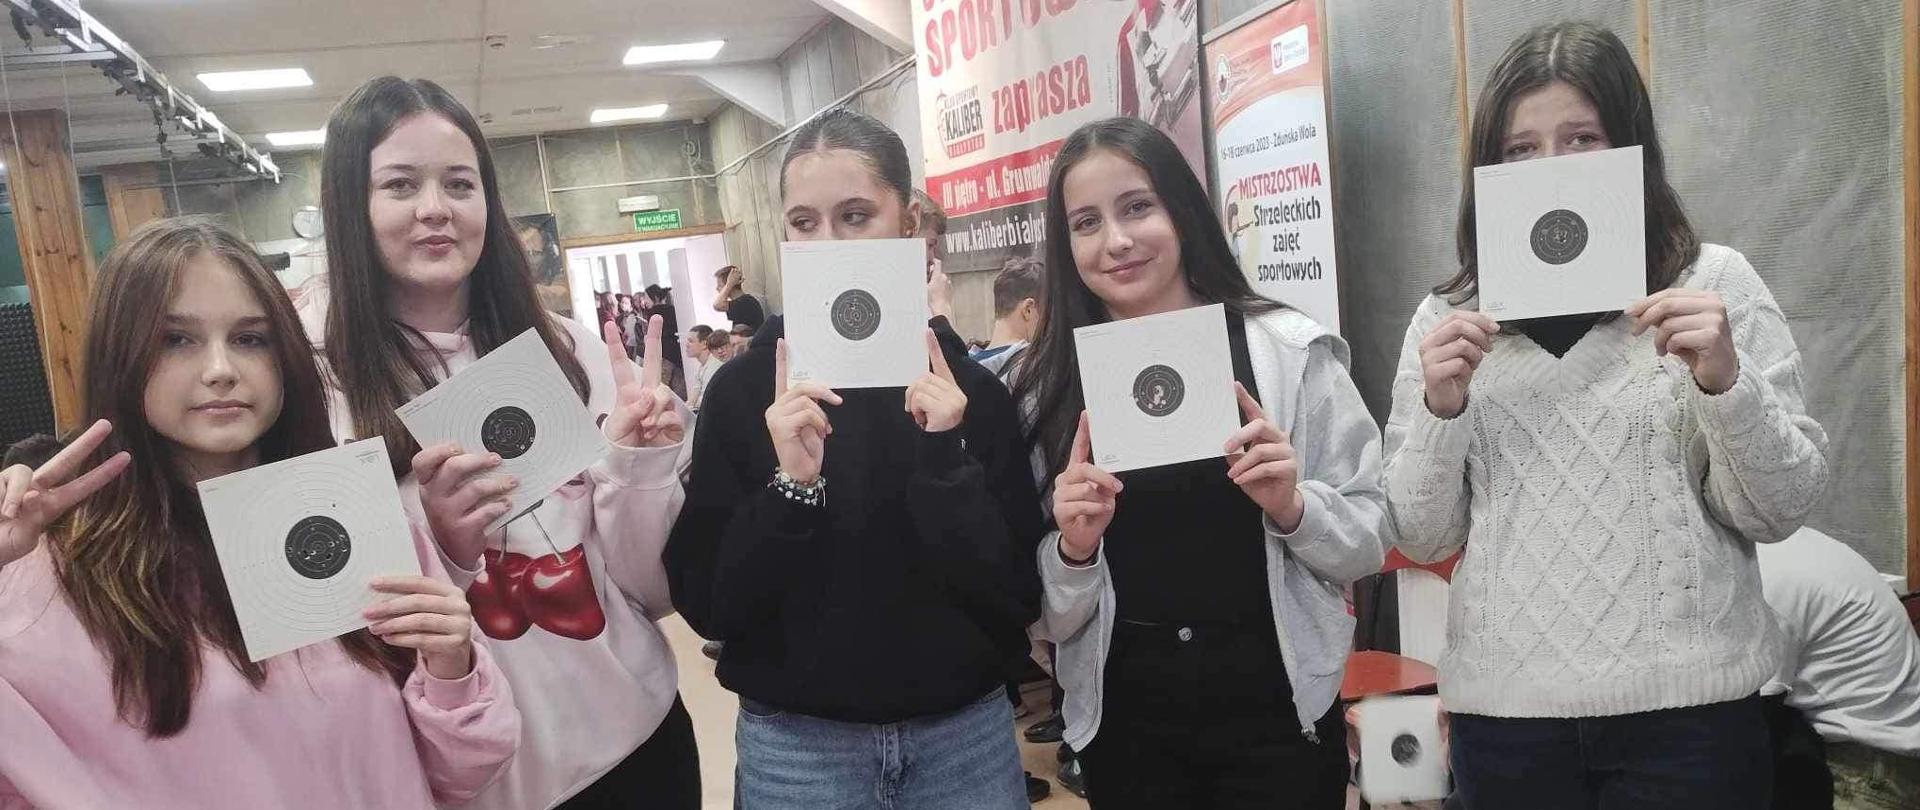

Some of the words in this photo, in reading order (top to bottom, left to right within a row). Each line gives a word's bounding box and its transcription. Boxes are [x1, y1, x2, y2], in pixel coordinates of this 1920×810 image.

[991, 54, 1091, 134] zaprasza
[945, 98, 984, 141] KALIBER
[1256, 136, 1270, 152] 2023
[1299, 123, 1317, 141] Wola
[986, 168, 1001, 200] ul.
[1239, 162, 1322, 200] MISTRZOSTWA
[637, 213, 677, 225] WYJŚCIE
[1254, 195, 1321, 227] Strzeleckich
[1272, 226, 1301, 256] zajęć
[1258, 256, 1322, 282] sportowych
